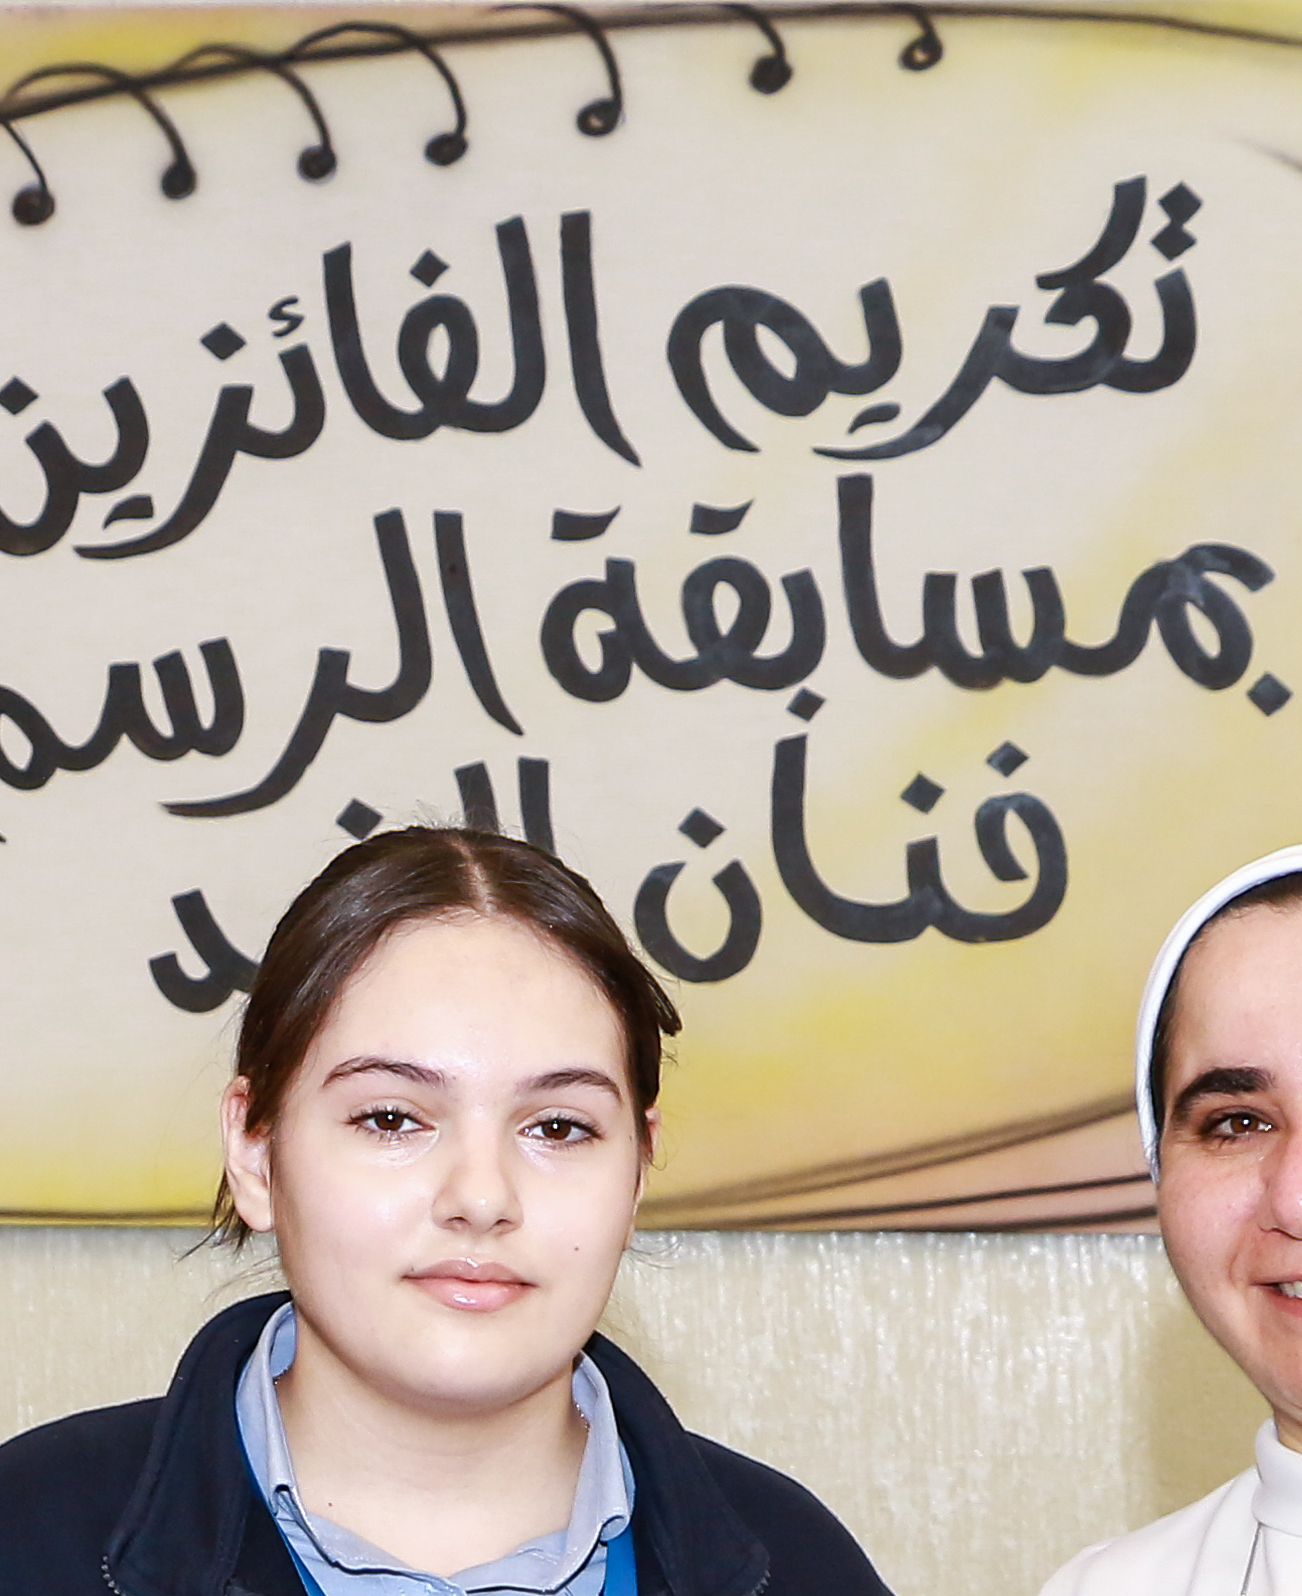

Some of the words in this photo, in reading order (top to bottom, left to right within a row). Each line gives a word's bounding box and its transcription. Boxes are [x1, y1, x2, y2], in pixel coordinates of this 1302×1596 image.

[668, 175, 1202, 460] تكريم
[538, 473, 1293, 718] بمسابقة
[631, 687, 1069, 982] فنان
